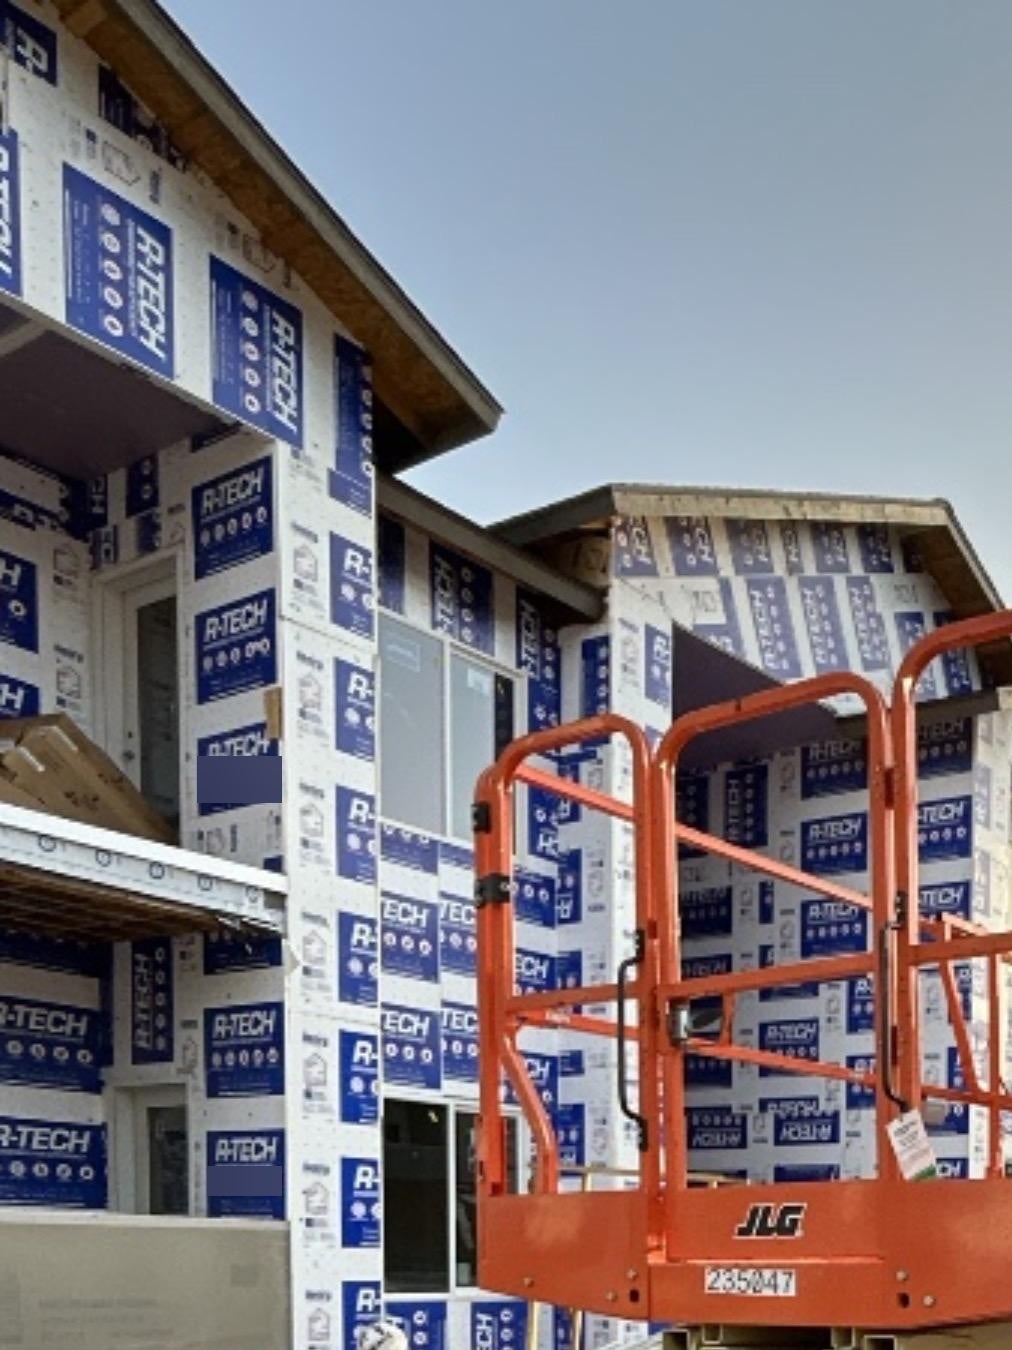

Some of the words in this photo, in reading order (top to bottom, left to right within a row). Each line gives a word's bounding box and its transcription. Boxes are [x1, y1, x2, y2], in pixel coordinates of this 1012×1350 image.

[136, 226, 167, 360] R-TECH
[272, 311, 298, 434] R-TECH
[202, 467, 264, 513] R-TECH
[204, 599, 268, 642] R-TECH
[808, 817, 862, 839] R-TECH
[212, 1010, 276, 1038] R-TECH
[215, 1136, 278, 1162] R-TECH
[734, 1204, 806, 1239] JLG
[707, 1269, 794, 1294] 235047
